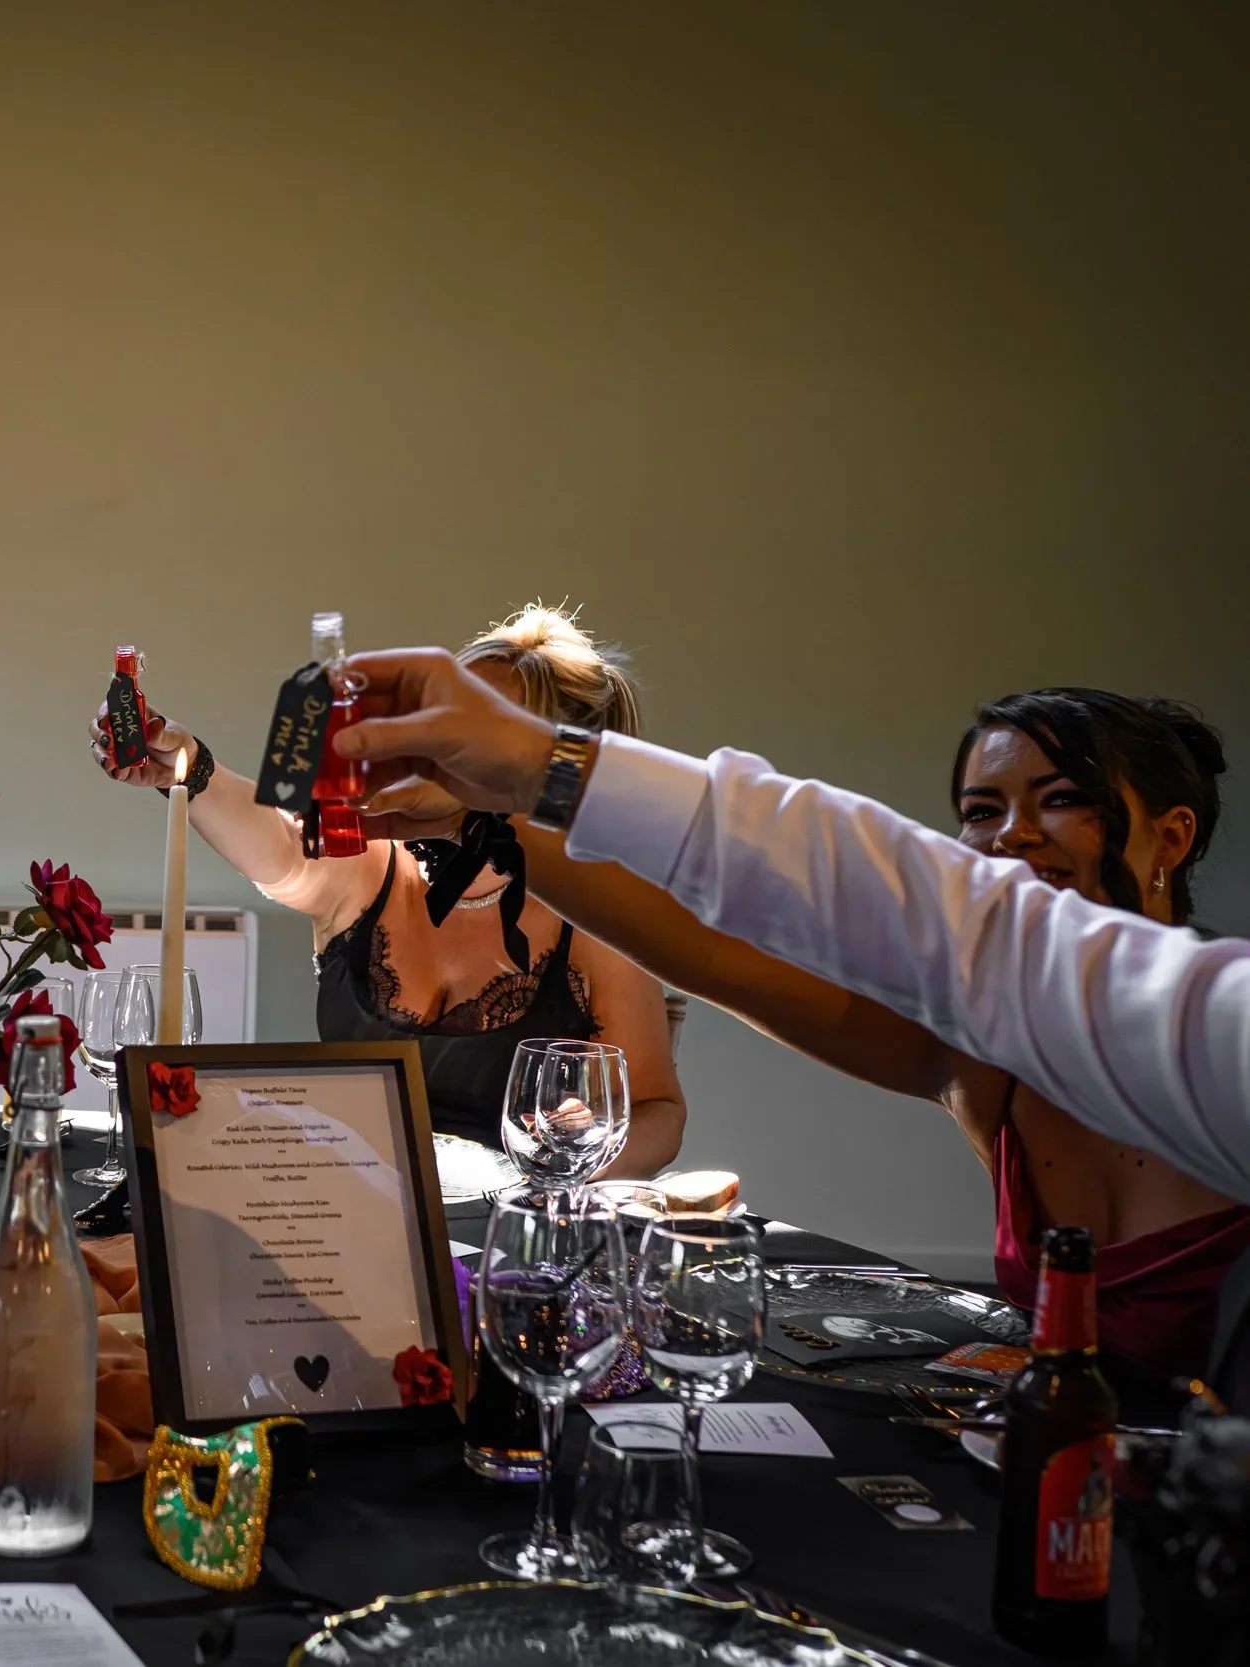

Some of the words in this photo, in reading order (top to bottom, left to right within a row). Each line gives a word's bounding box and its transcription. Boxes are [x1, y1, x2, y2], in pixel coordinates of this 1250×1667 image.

[112, 711, 123, 735] me
[120, 688, 139, 736] Drink
[275, 715, 294, 748] me
[286, 694, 328, 774] Drink
